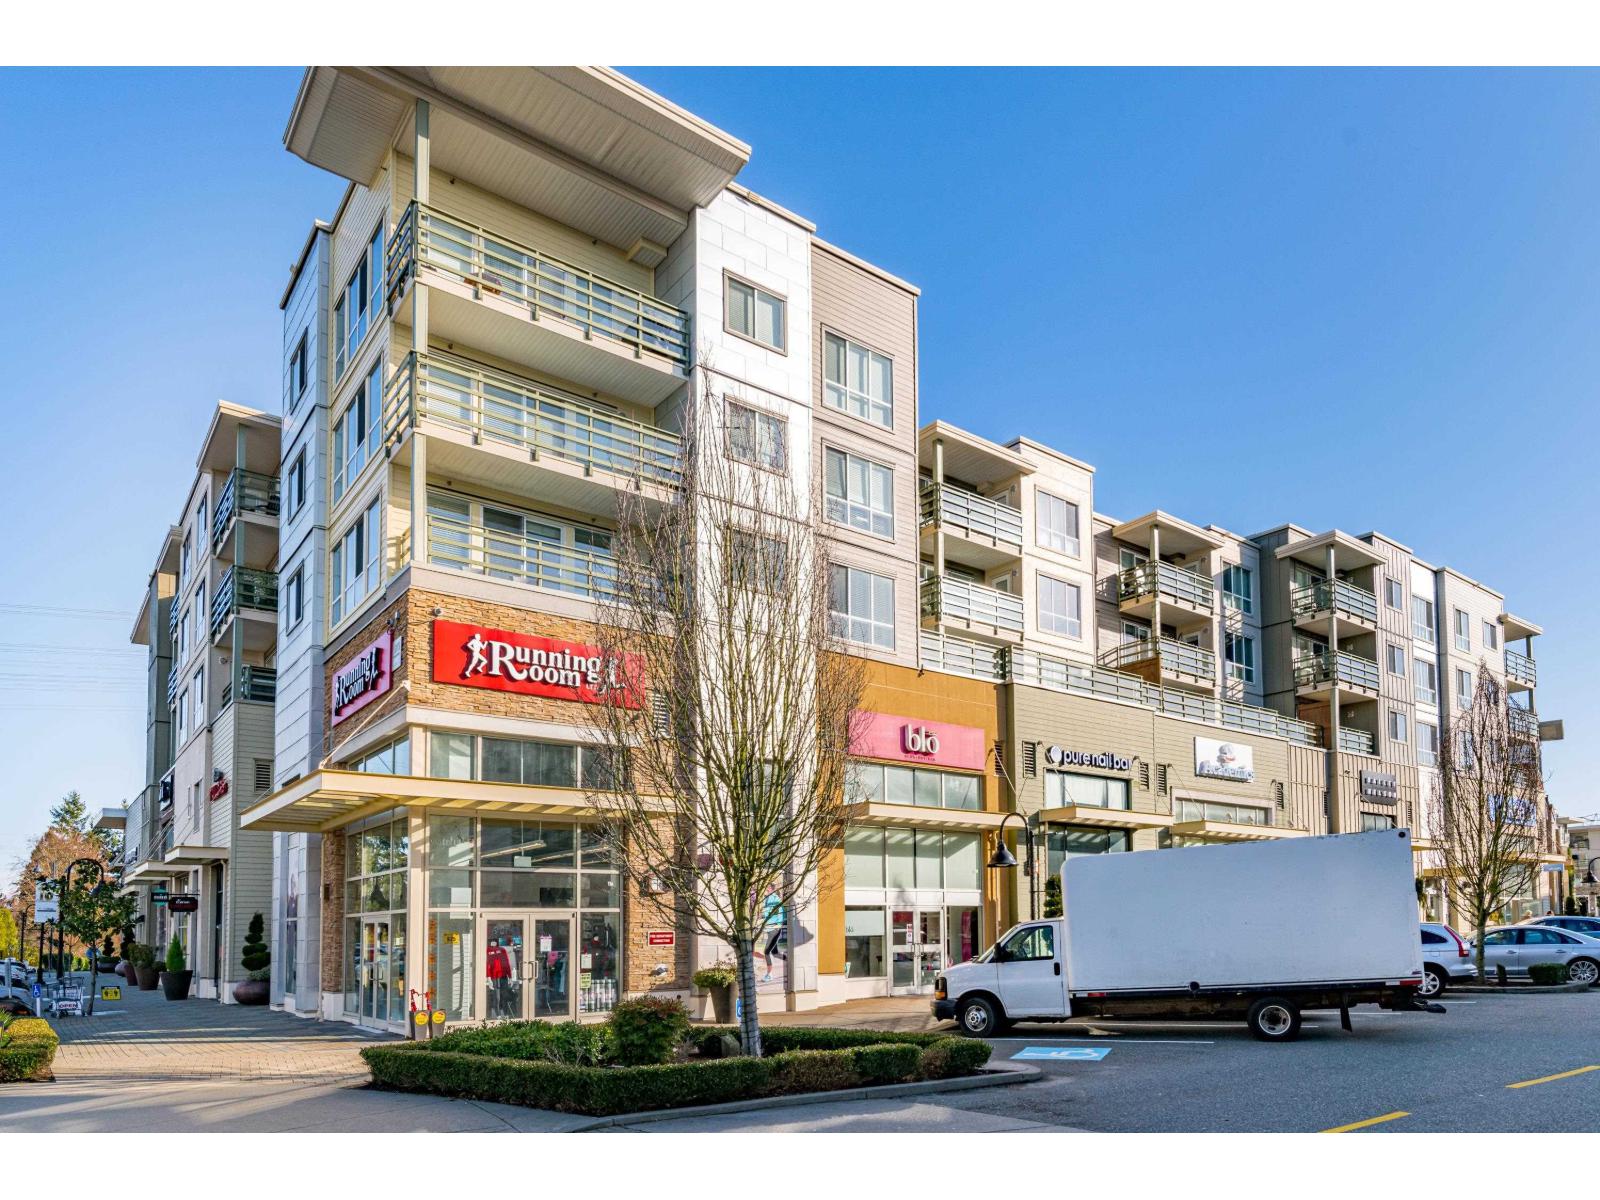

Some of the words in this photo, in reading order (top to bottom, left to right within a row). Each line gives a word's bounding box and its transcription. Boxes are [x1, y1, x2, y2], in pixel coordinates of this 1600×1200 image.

[340, 652, 372, 705] Running
[489, 640, 602, 683] Running
[1064, 750, 1090, 765] pure
[1092, 752, 1112, 769] nail
